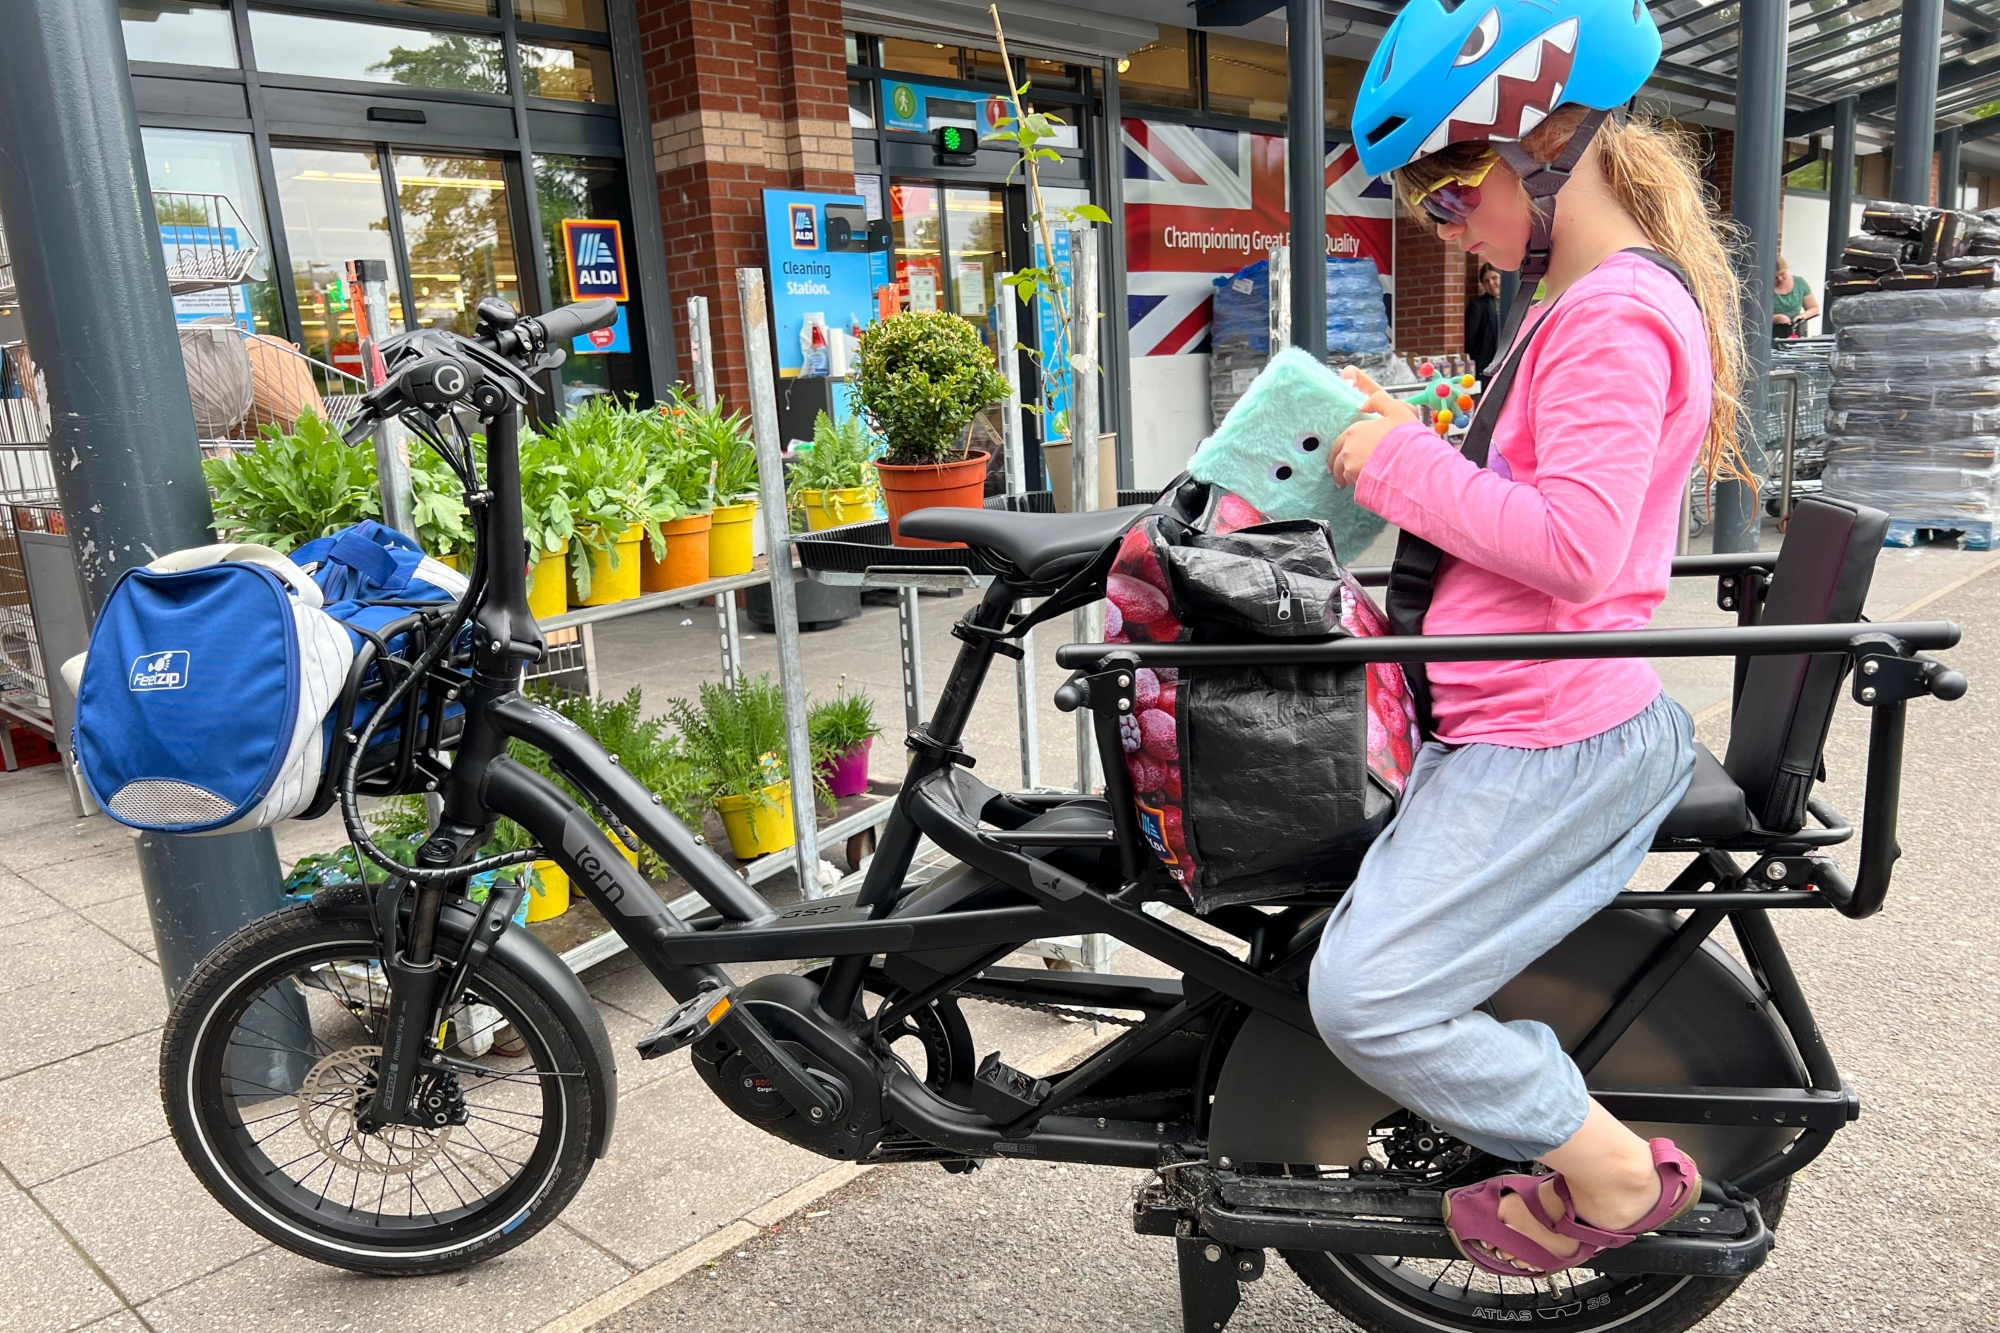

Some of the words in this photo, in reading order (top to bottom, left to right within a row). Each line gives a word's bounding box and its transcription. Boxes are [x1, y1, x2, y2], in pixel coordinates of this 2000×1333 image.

[795, 231, 813, 240] ALDI
[1164, 226, 1250, 255] Championing
[1252, 230, 1284, 250] Great
[579, 269, 618, 285] ALDI
[783, 261, 831, 278] Cleaning
[787, 280, 830, 295] Station.
[573, 844, 625, 905] tern
[781, 906, 841, 918] GSD
[755, 1079, 773, 1087] BOS
[531, 1167, 562, 1211] SCHWALBE
[439, 1249, 463, 1260] PLUS
[1472, 1306, 1532, 1322] ATLAS
[1587, 1293, 1611, 1310] 36
